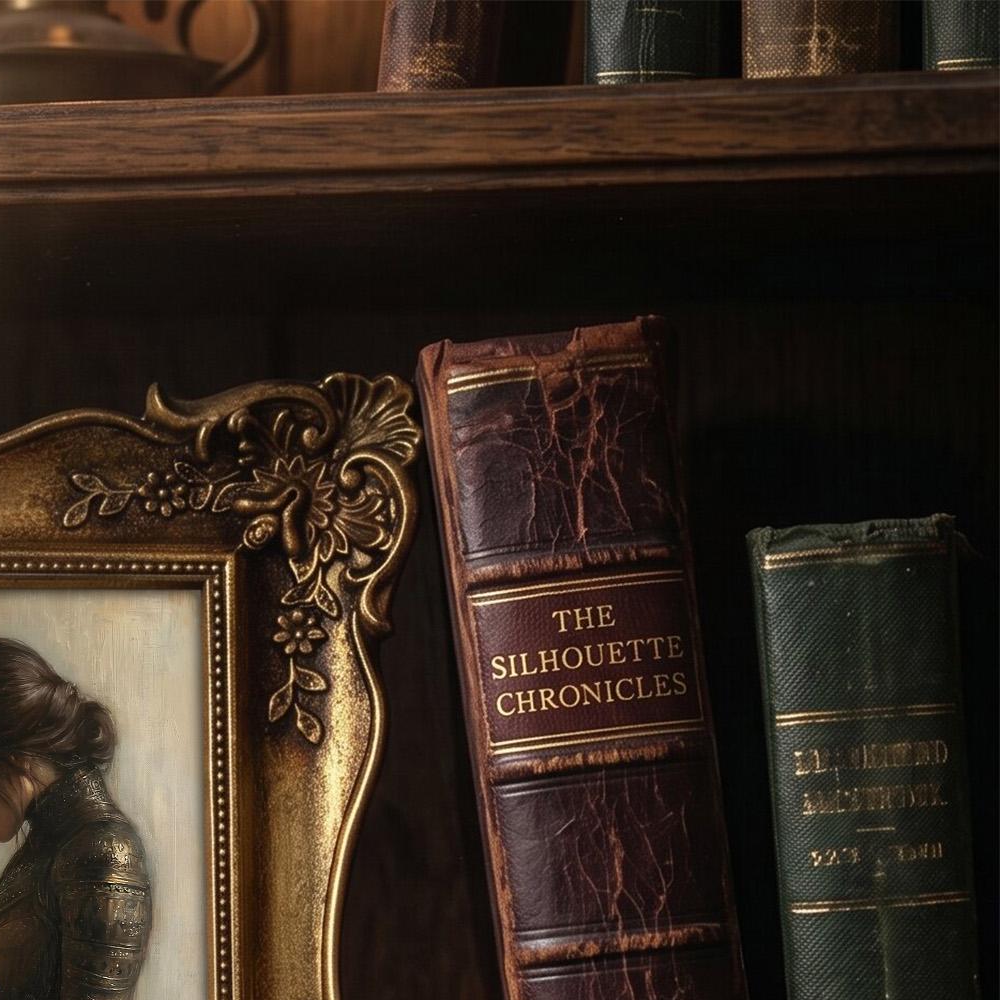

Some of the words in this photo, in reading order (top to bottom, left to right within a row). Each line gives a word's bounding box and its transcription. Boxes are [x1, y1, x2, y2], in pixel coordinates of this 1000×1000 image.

[552, 604, 616, 633] THE
[490, 635, 685, 680] SILHOUETTE
[496, 672, 688, 716] CHRONICLES
